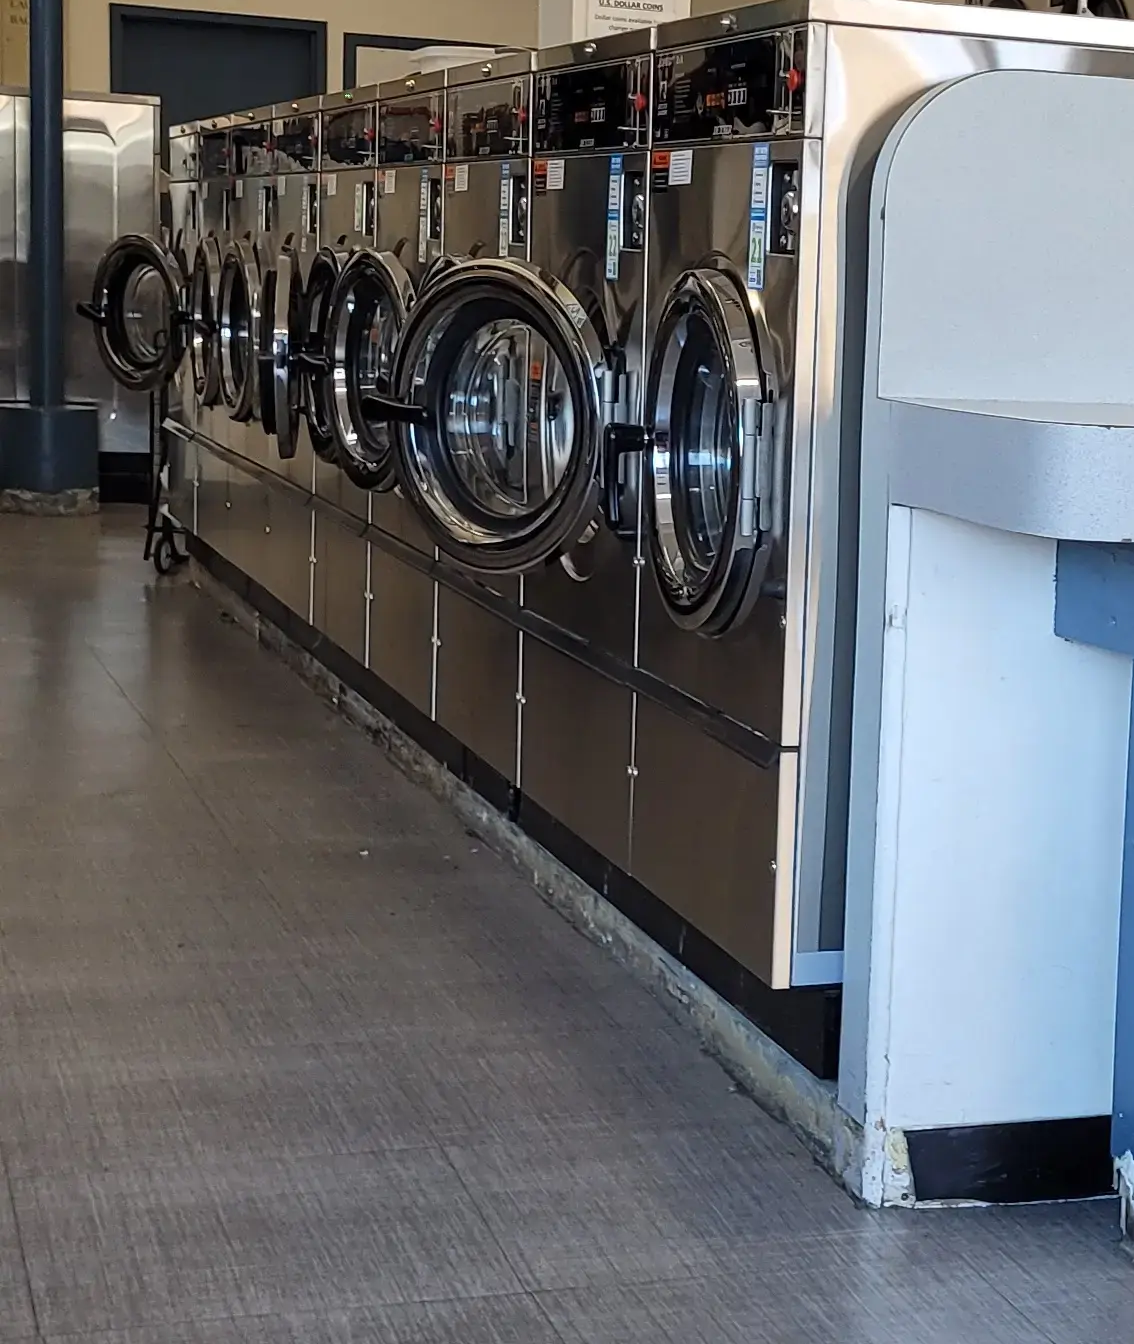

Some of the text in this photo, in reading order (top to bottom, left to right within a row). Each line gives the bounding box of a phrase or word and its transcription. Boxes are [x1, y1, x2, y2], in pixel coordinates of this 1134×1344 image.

[614, 0, 641, 9] DOLLAR
[642, 3, 664, 12] COINS
[750, 237, 762, 264] 21
